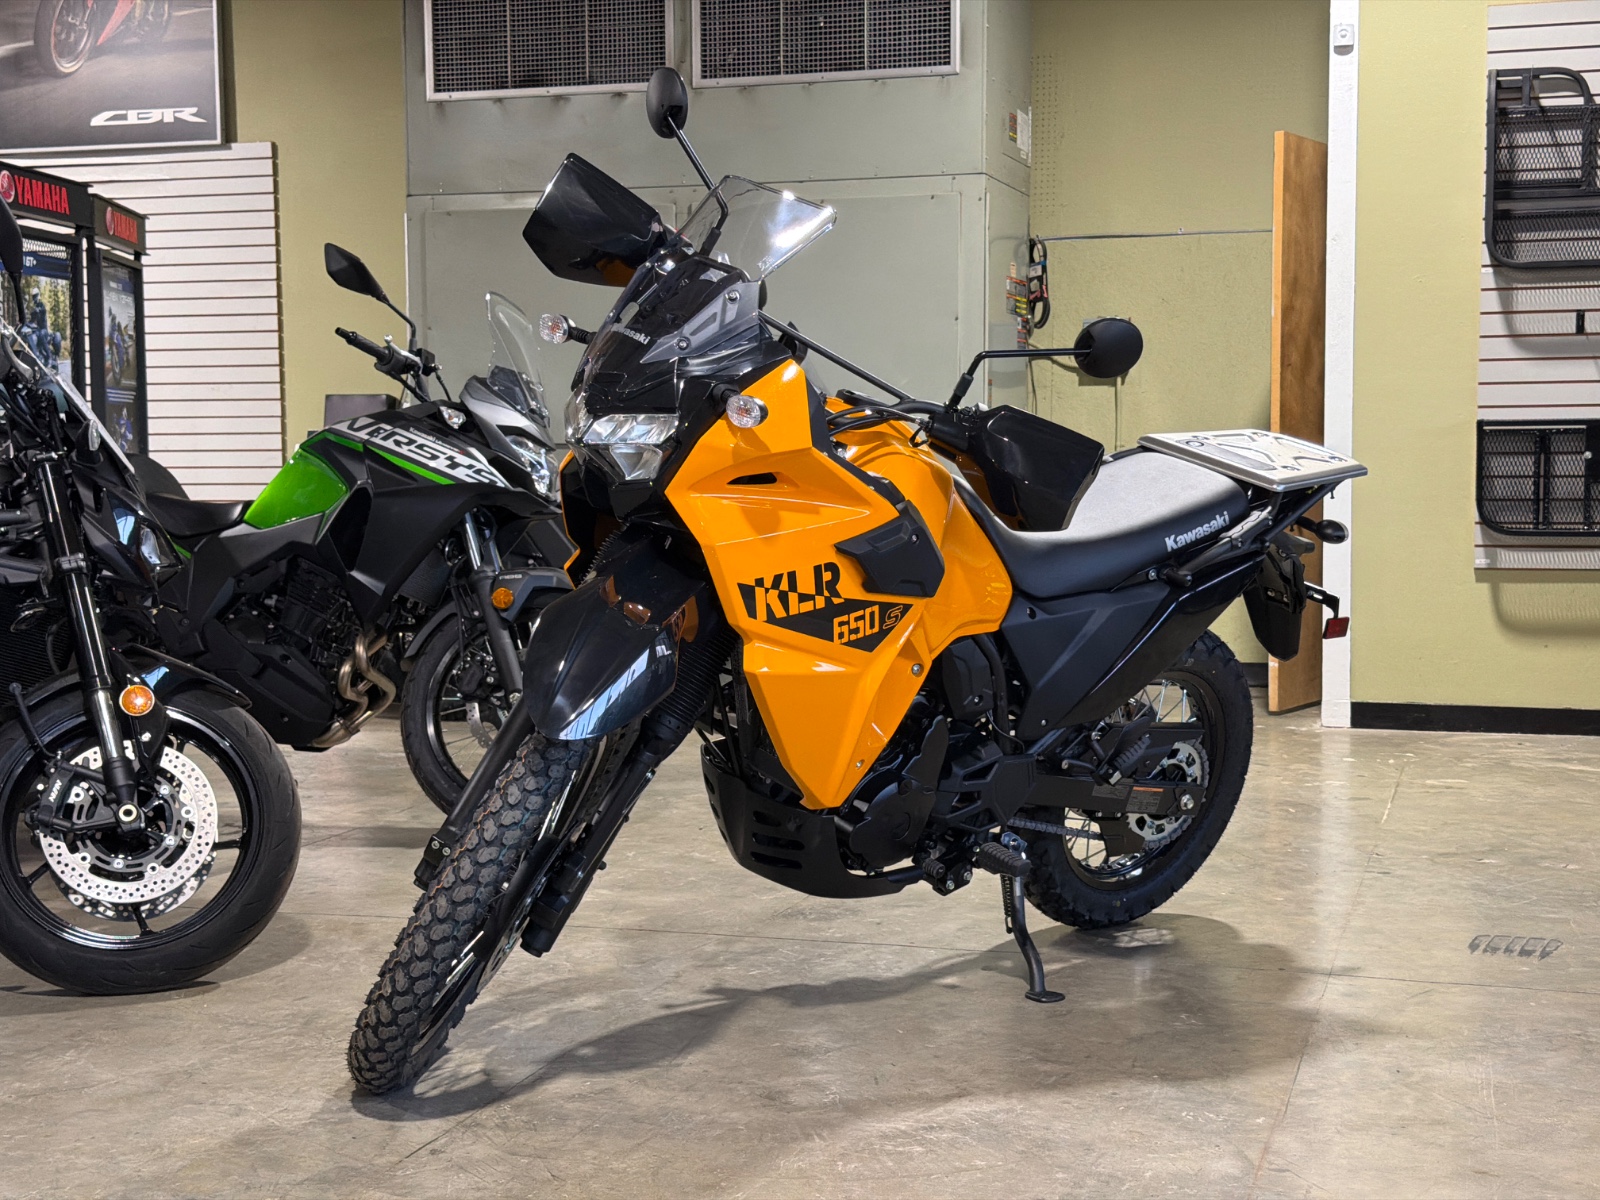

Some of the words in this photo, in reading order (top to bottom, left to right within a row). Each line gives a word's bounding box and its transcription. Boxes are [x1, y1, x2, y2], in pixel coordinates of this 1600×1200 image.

[90, 106, 207, 127] CBR
[14, 174, 70, 215] YAMAHA
[113, 210, 139, 244] YAMAHA
[612, 322, 651, 345] wasaki
[1164, 510, 1230, 552] Kawasaki
[754, 561, 845, 622] KLR
[833, 604, 880, 646] 650
[882, 604, 904, 630] S
